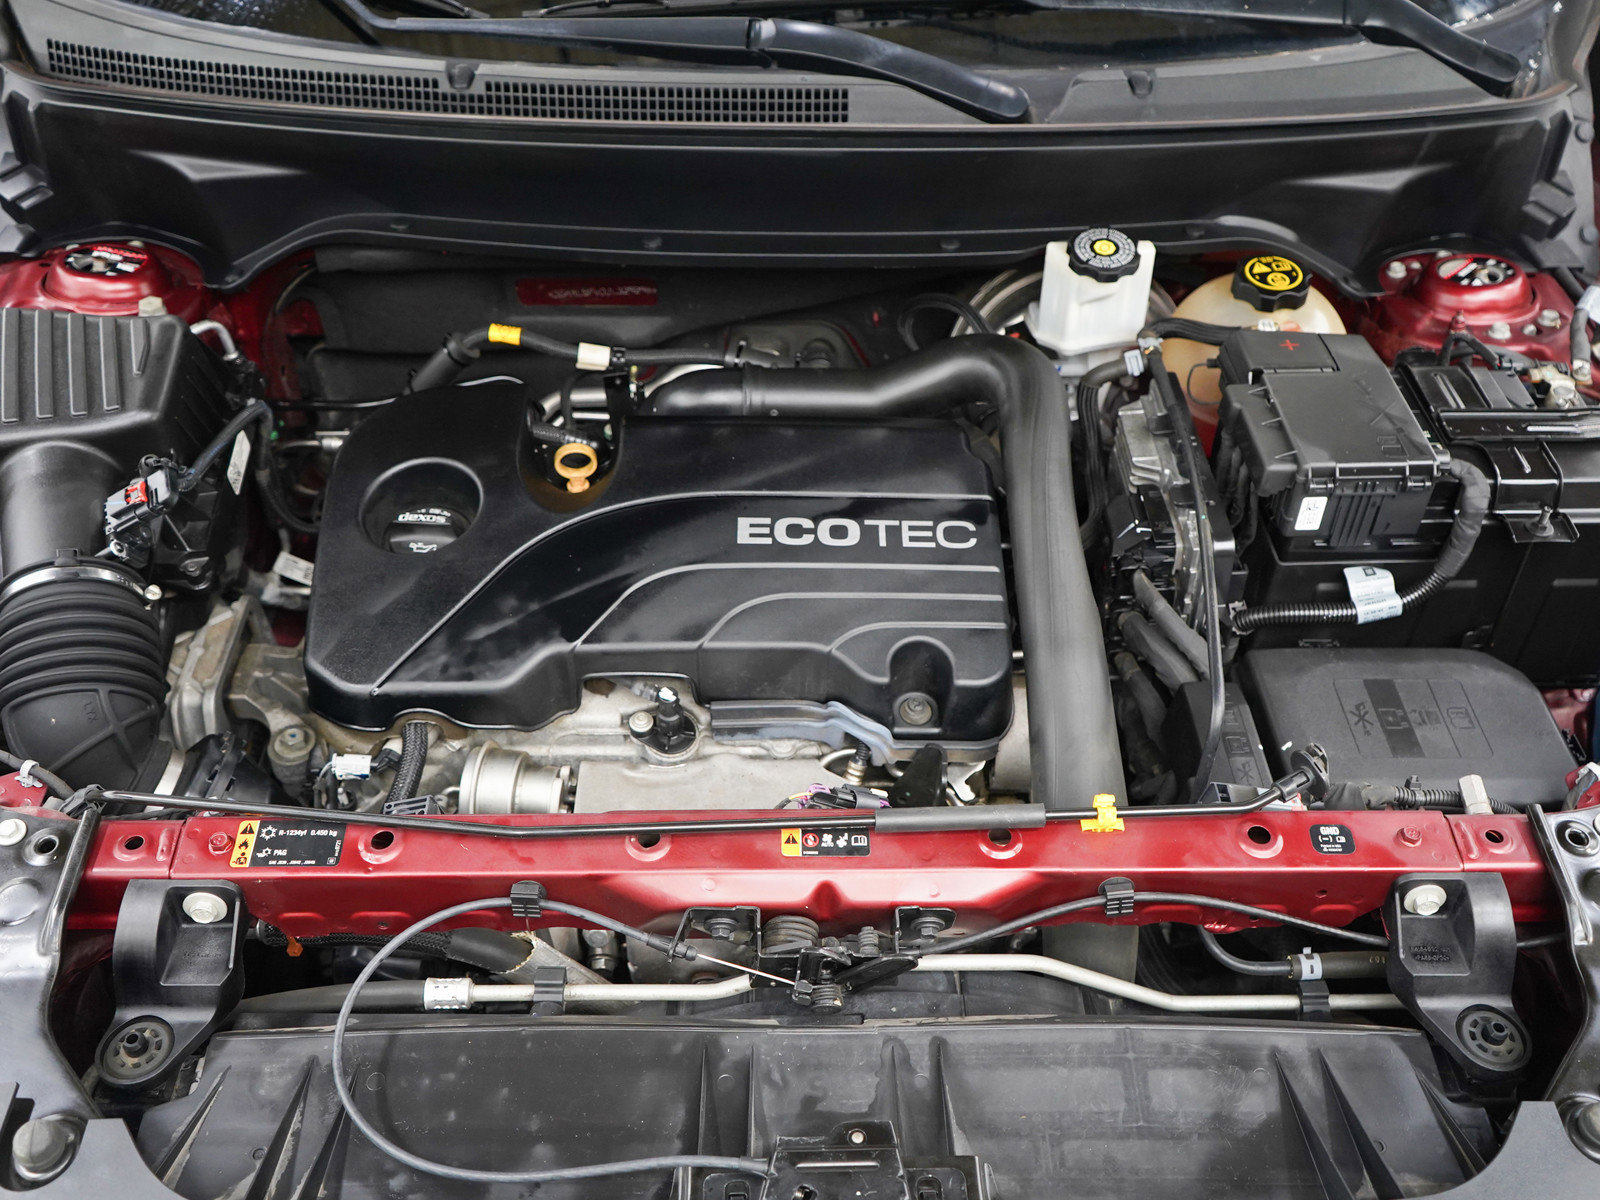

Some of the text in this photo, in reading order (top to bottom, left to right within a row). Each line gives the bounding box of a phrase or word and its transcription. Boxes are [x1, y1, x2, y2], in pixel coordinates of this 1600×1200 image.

[398, 511, 446, 523] dexos
[736, 517, 978, 549] ECOTEC
[278, 829, 307, 837] R-1234yf
[1320, 826, 1340, 836] GND
